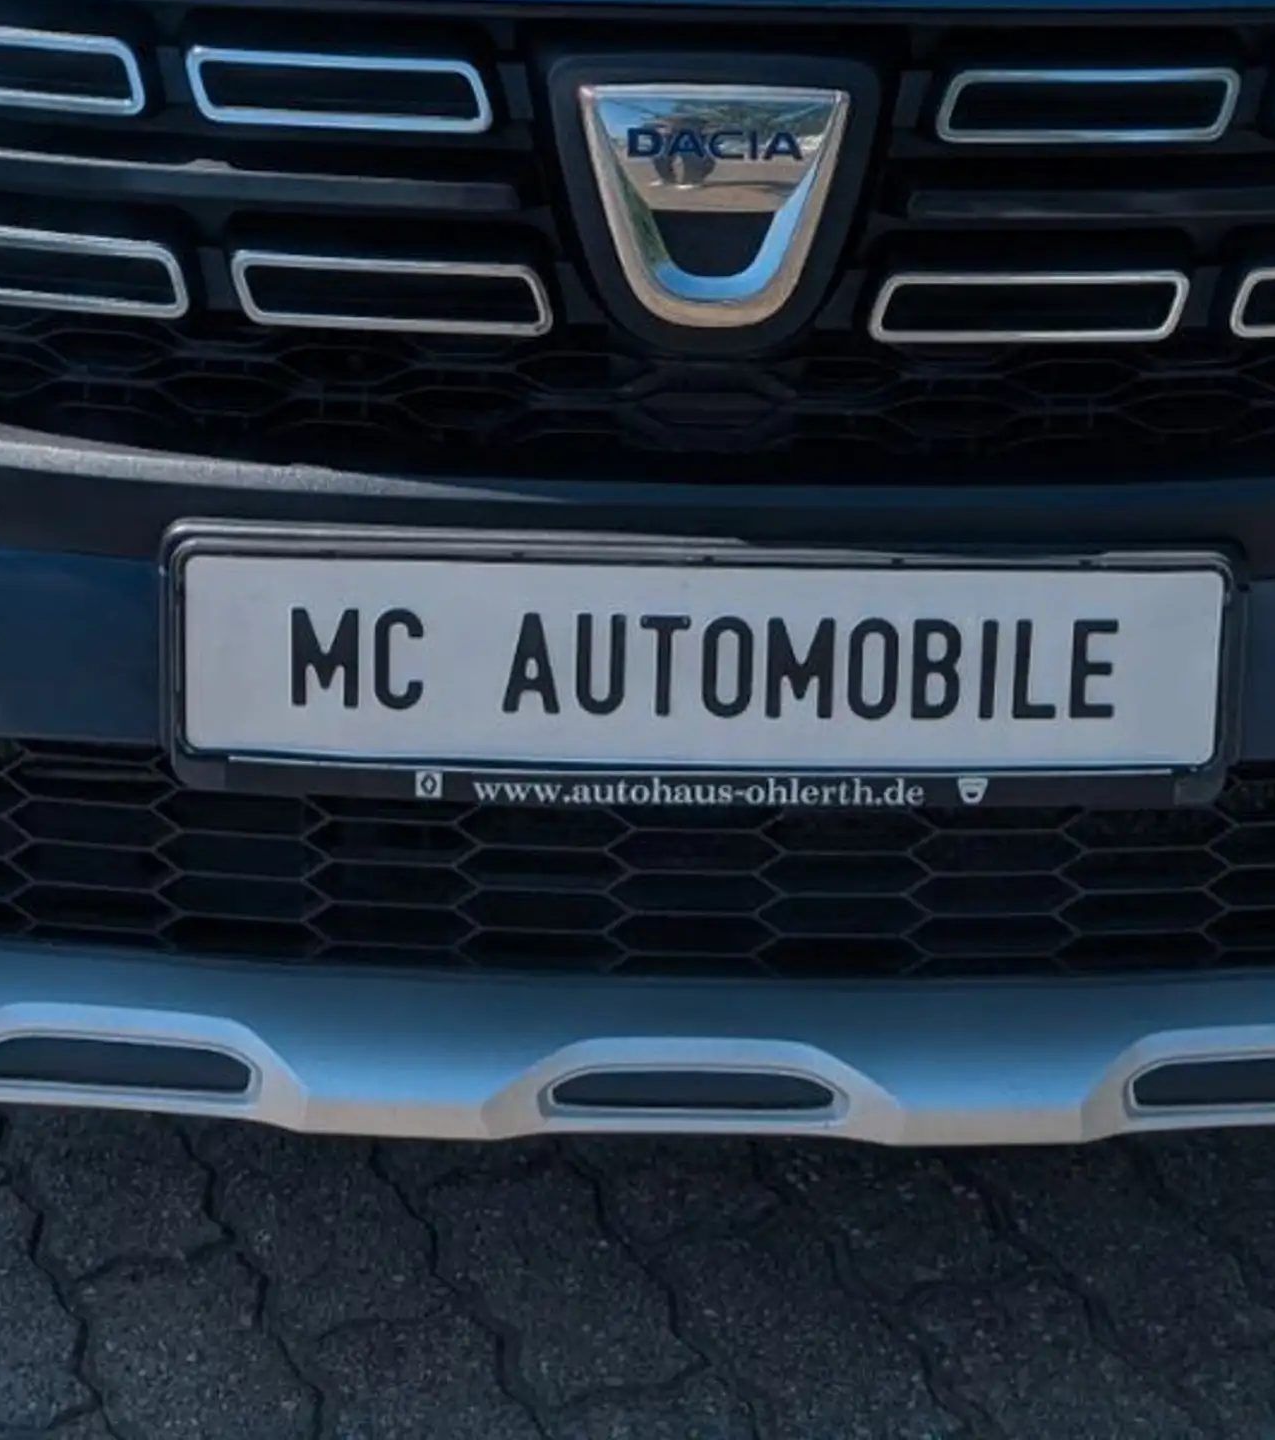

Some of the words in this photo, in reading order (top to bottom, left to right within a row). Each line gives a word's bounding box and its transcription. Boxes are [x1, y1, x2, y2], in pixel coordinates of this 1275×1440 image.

[627, 127, 804, 161] DACIA
[289, 606, 425, 712] MC
[501, 612, 1121, 720] AUTOMOBILE
[472, 775, 925, 808] www.autohaus-ohlerth.de
